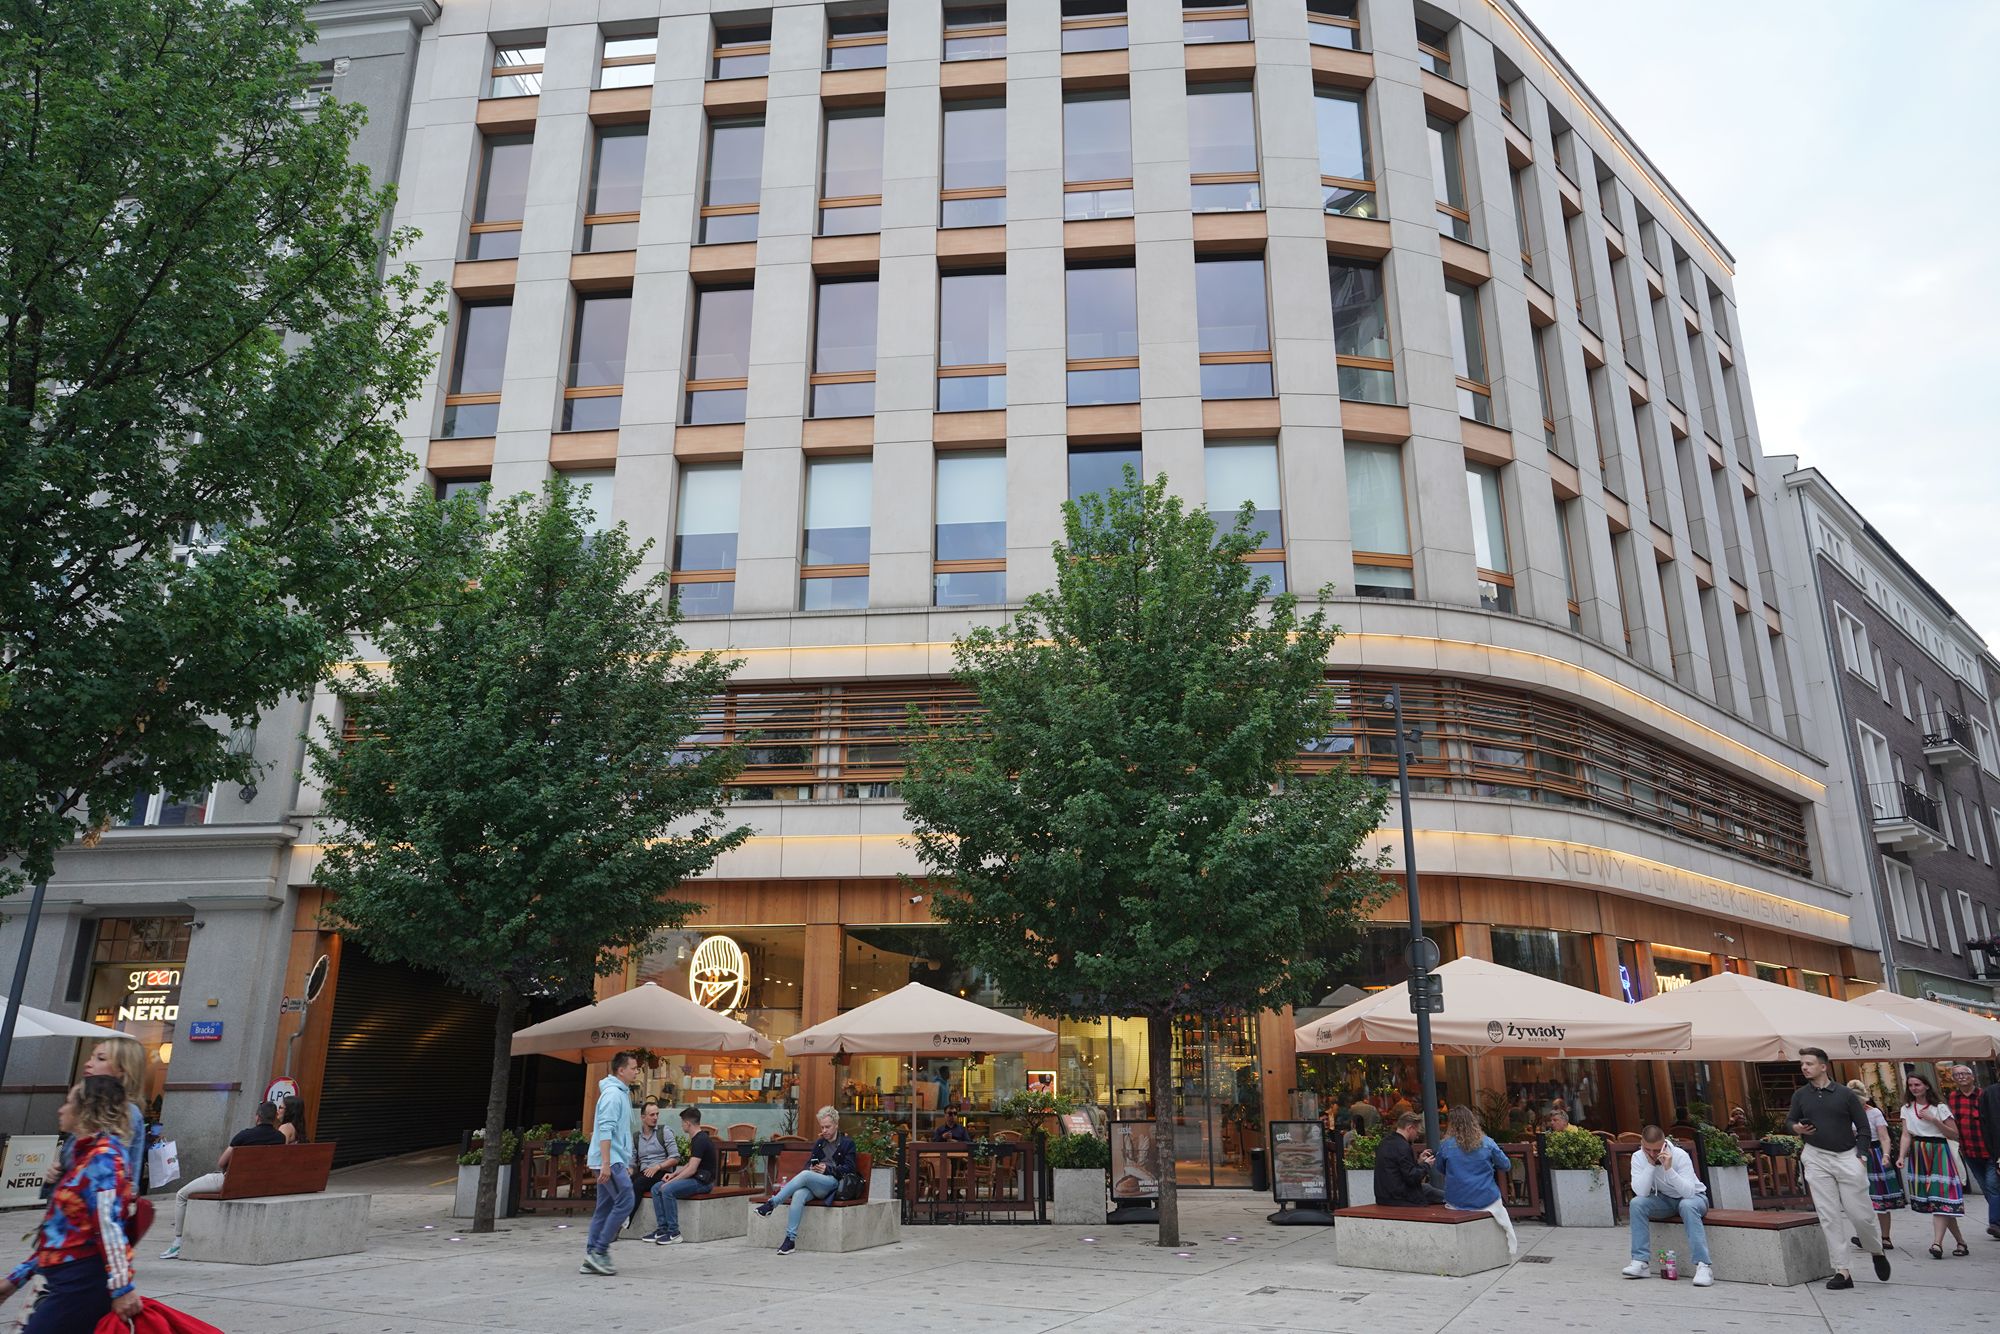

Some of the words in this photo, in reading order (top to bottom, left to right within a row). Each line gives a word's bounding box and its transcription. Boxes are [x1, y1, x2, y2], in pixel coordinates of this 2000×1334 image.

[1547, 845, 1626, 884] NOWY
[127, 970, 180, 991] green
[117, 1005, 180, 1021] NERO
[194, 1026, 215, 1034] Bracka
[600, 1030, 631, 1041] Żywioły
[1507, 1022, 1566, 1041] Żywioły
[942, 1034, 972, 1046] Żywioły
[1858, 1035, 1891, 1052] Żywioły
[14, 1152, 46, 1167] green
[6, 1177, 43, 1190] NERO
